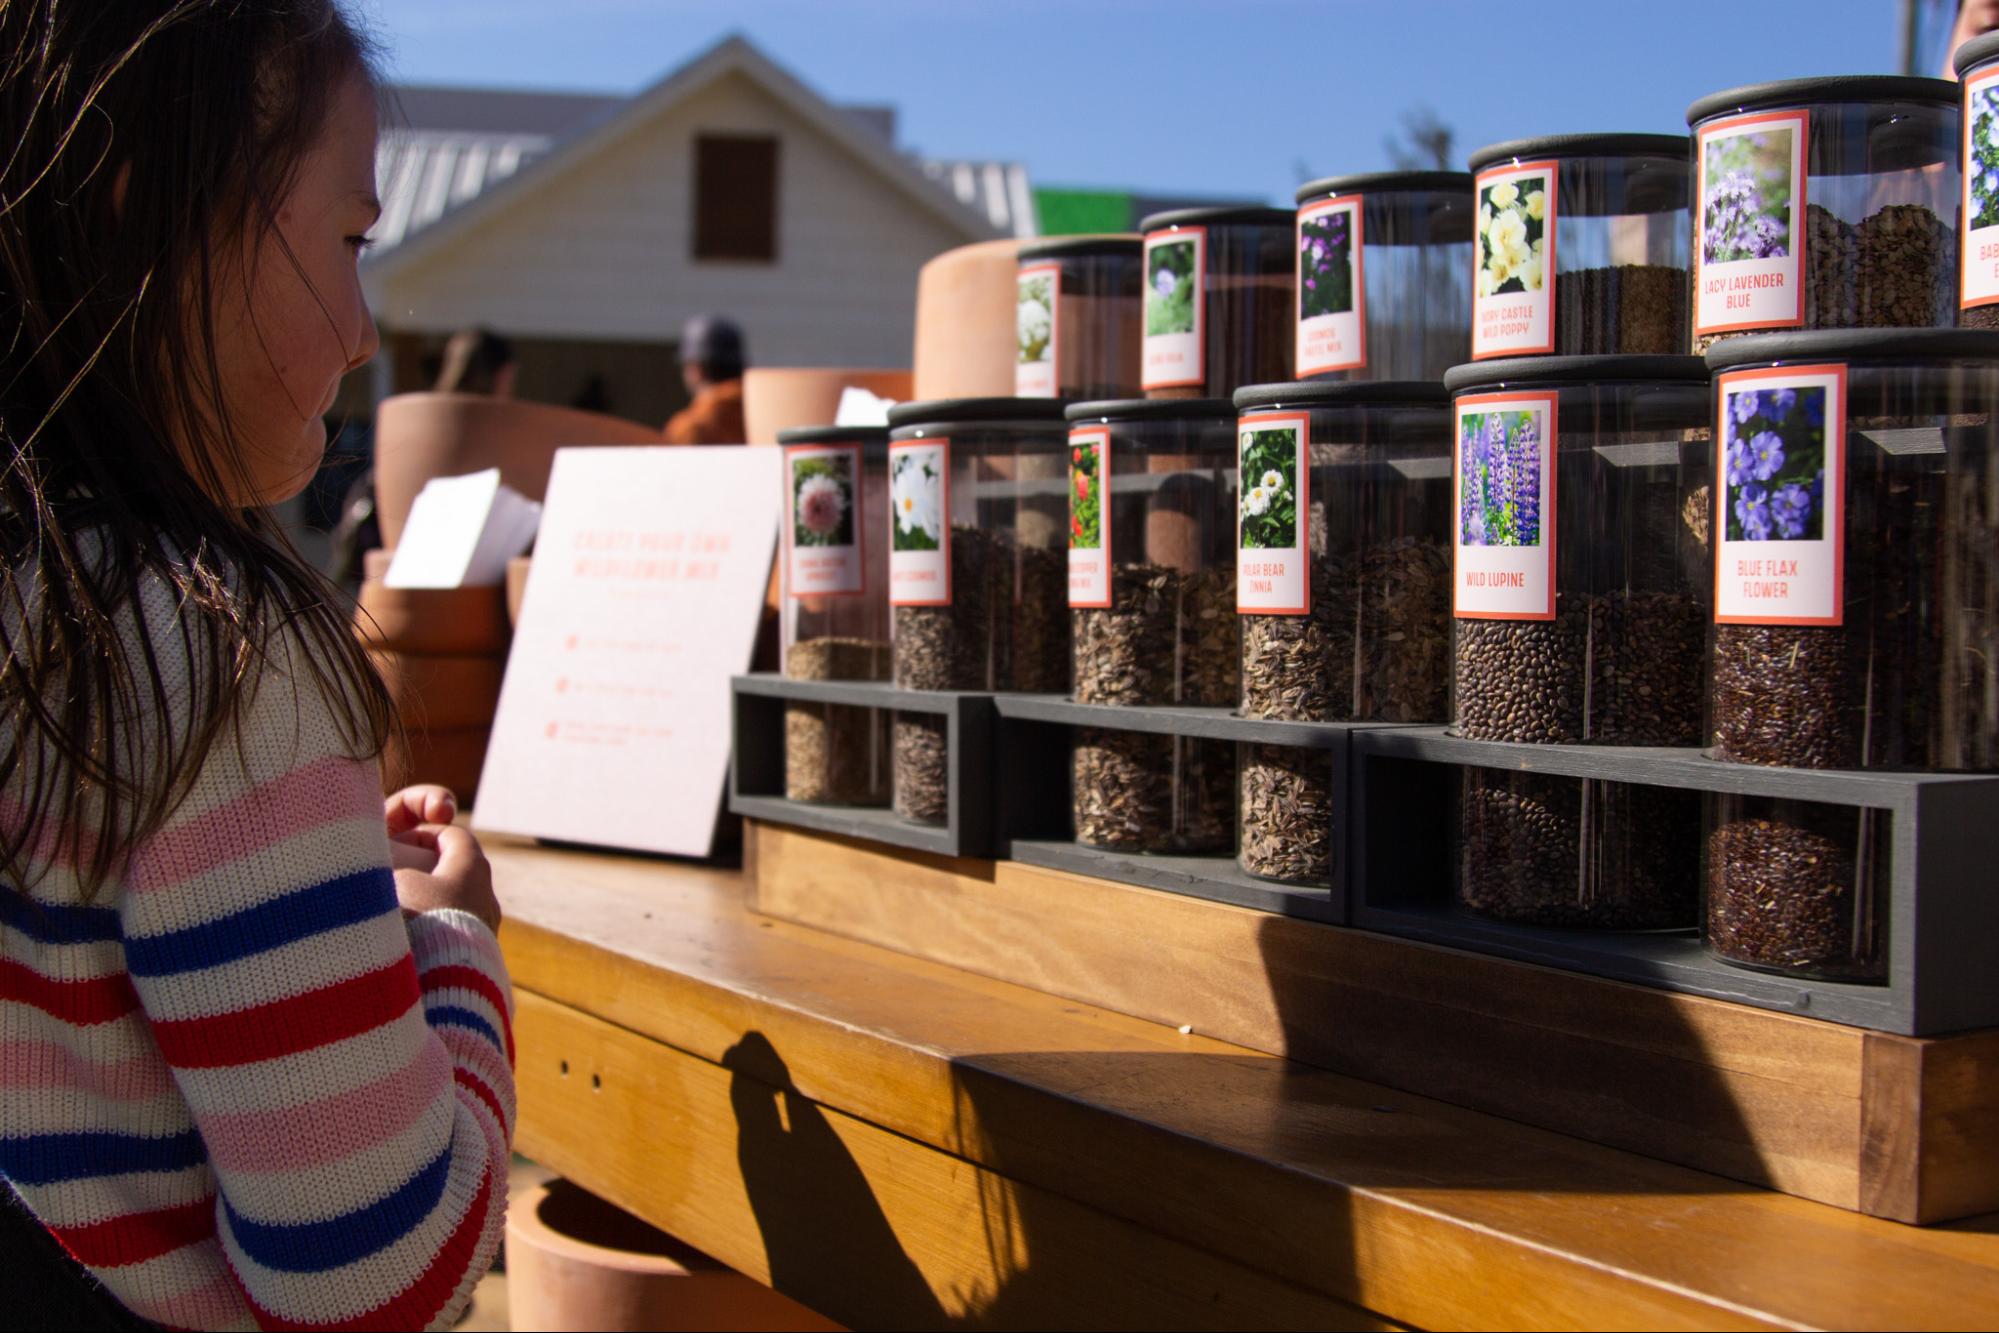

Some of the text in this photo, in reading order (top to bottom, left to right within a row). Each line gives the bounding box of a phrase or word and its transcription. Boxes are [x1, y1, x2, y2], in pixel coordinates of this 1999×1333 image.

[1705, 272, 1784, 294] LACY LAVENDER
[1727, 293, 1752, 310] BLUE
[1501, 304, 1534, 321] CASTLE
[1500, 321, 1530, 337] POPPY
[1263, 562, 1285, 577] BEAR
[1737, 559, 1798, 577] BLUE FLAX
[1466, 571, 1525, 588] WILD LUPINE
[1743, 581, 1789, 599] FLOWER
